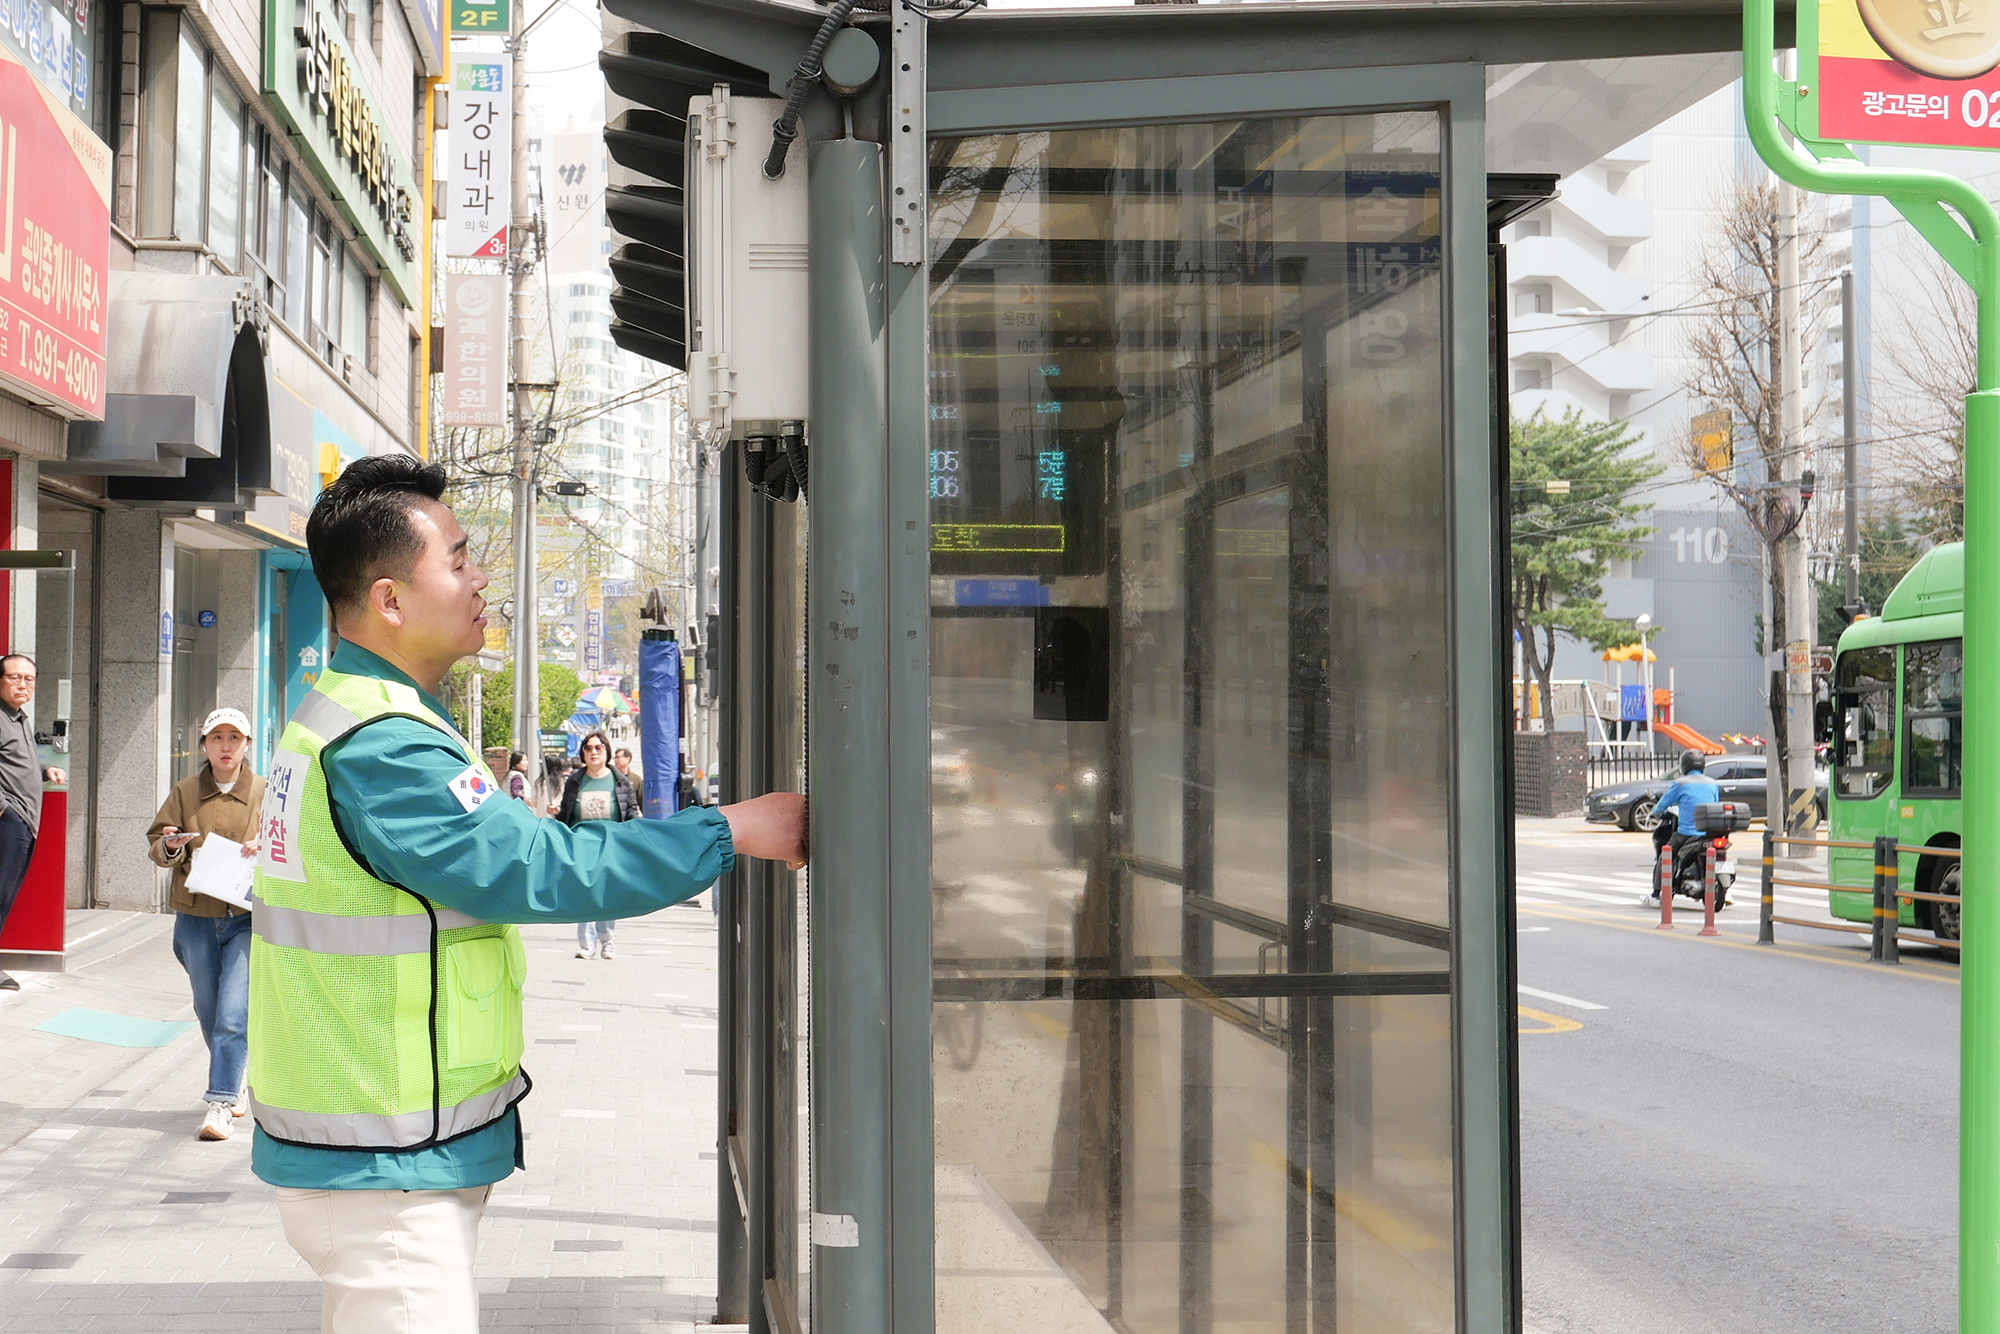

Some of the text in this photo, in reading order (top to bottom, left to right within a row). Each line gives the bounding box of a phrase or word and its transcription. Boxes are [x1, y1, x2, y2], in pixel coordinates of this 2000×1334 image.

[460, 10, 498, 26] 2F
[458, 67, 501, 91] 쌍문동
[1862, 91, 1949, 120] 광고문의
[556, 193, 588, 211] 신원
[464, 219, 490, 232] 의원
[489, 238, 505, 254] 3F
[18, 319, 98, 405] T.991-4900
[445, 411, 499, 423] 999-8181
[1669, 526, 1729, 564] 110
